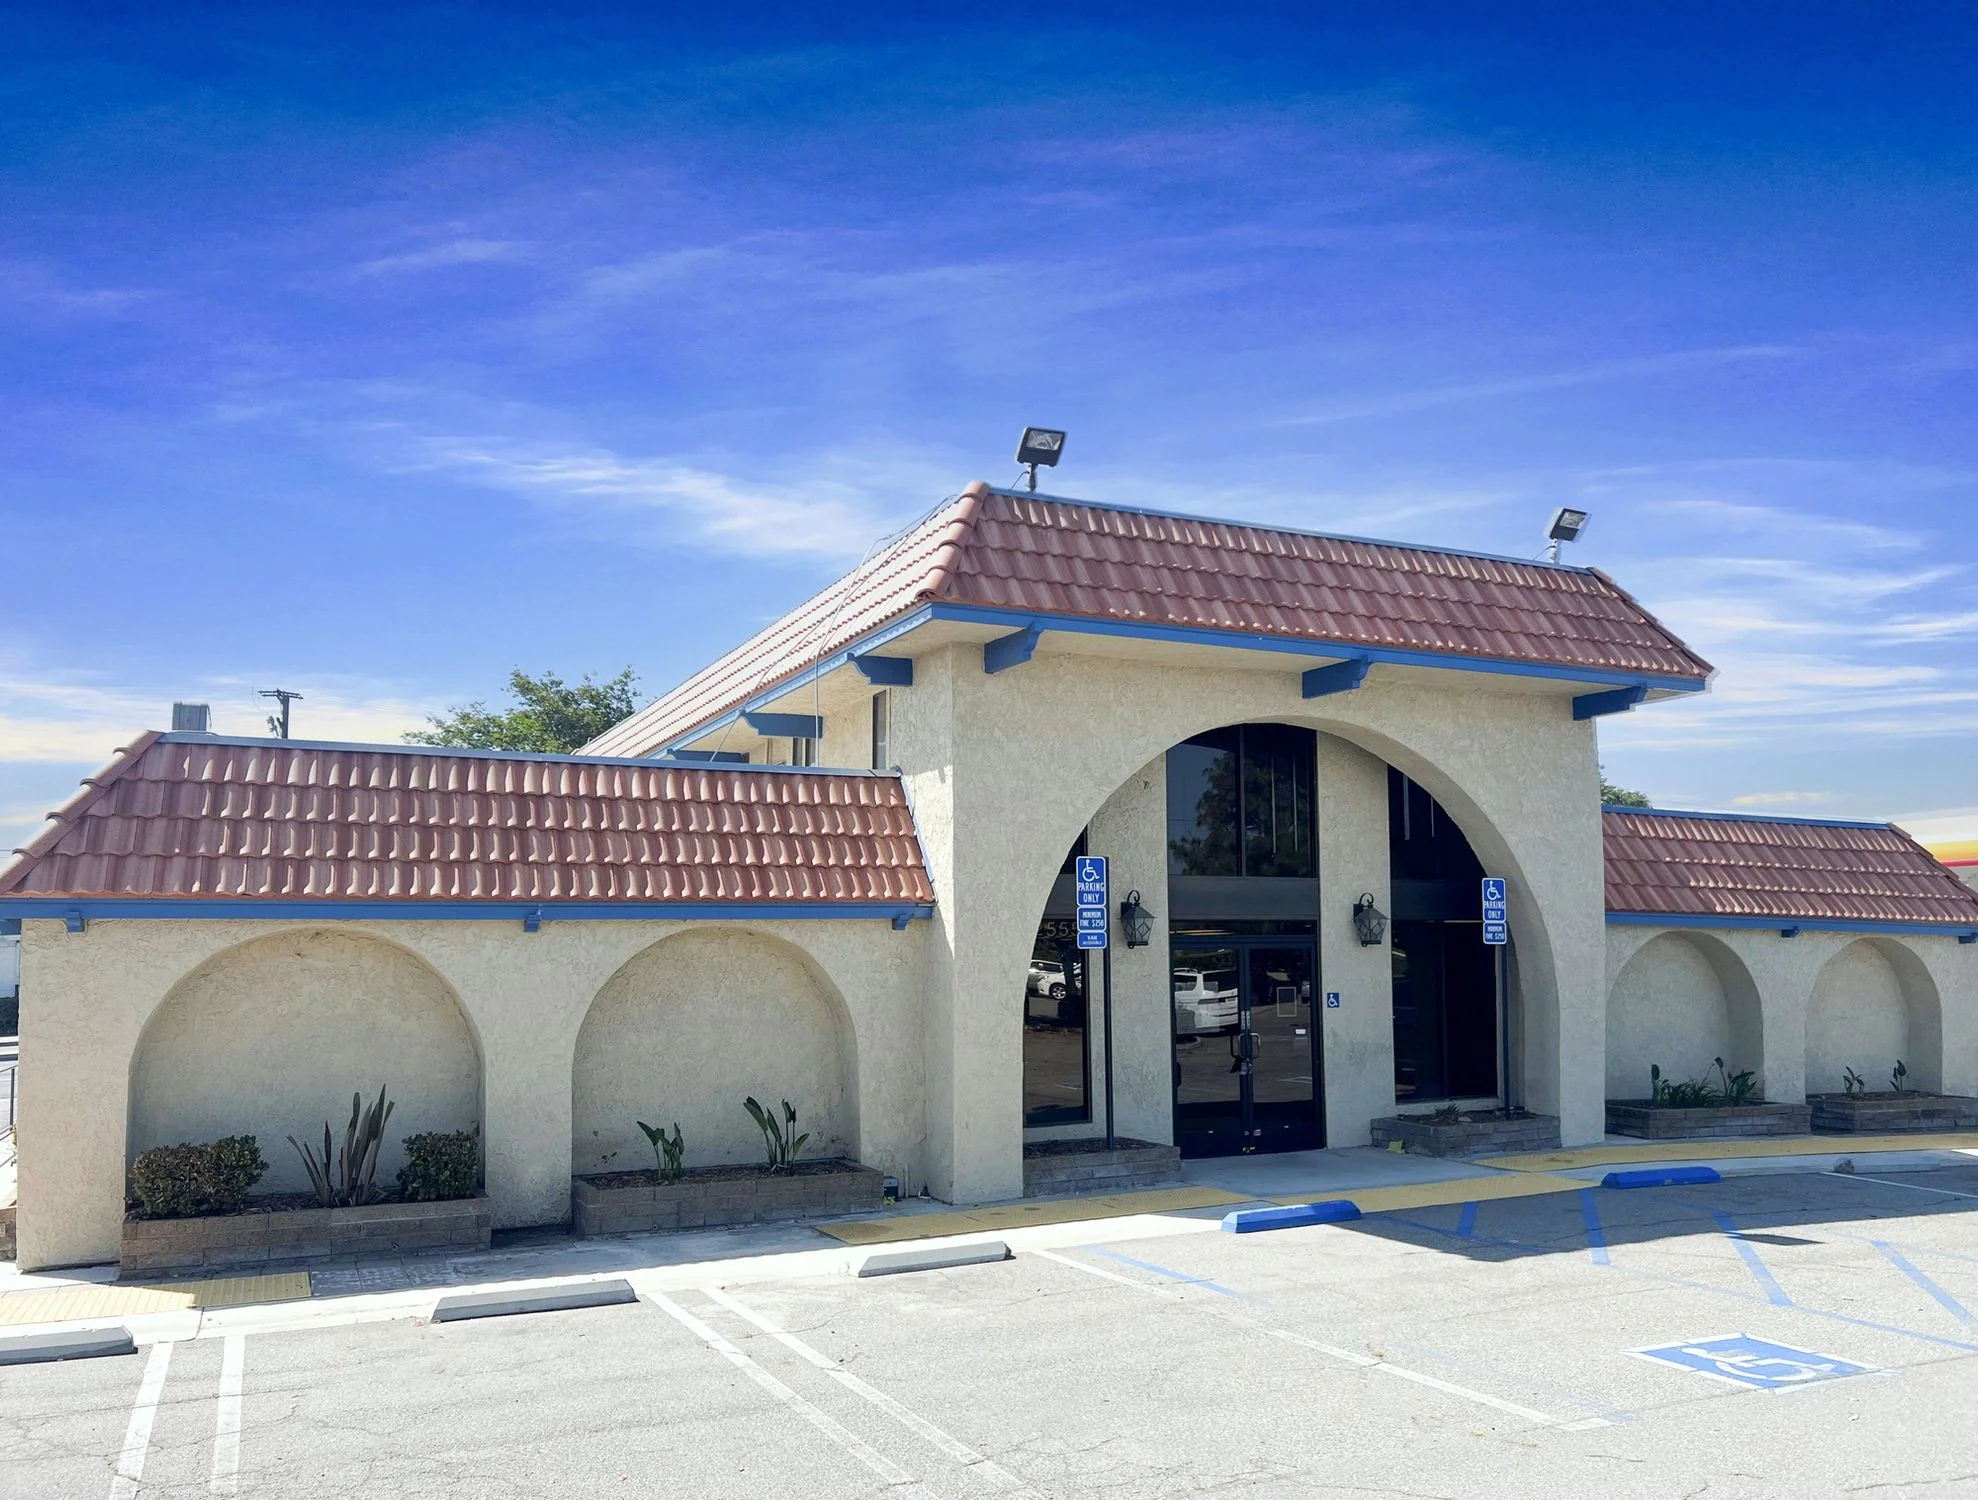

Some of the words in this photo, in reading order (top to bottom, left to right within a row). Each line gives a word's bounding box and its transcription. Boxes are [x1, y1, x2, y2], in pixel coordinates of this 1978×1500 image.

[1078, 882, 1104, 892] PARKING
[1083, 894, 1100, 903] ONLY
[1484, 900, 1504, 909] PARKING
[1488, 910, 1501, 919] ONLY
